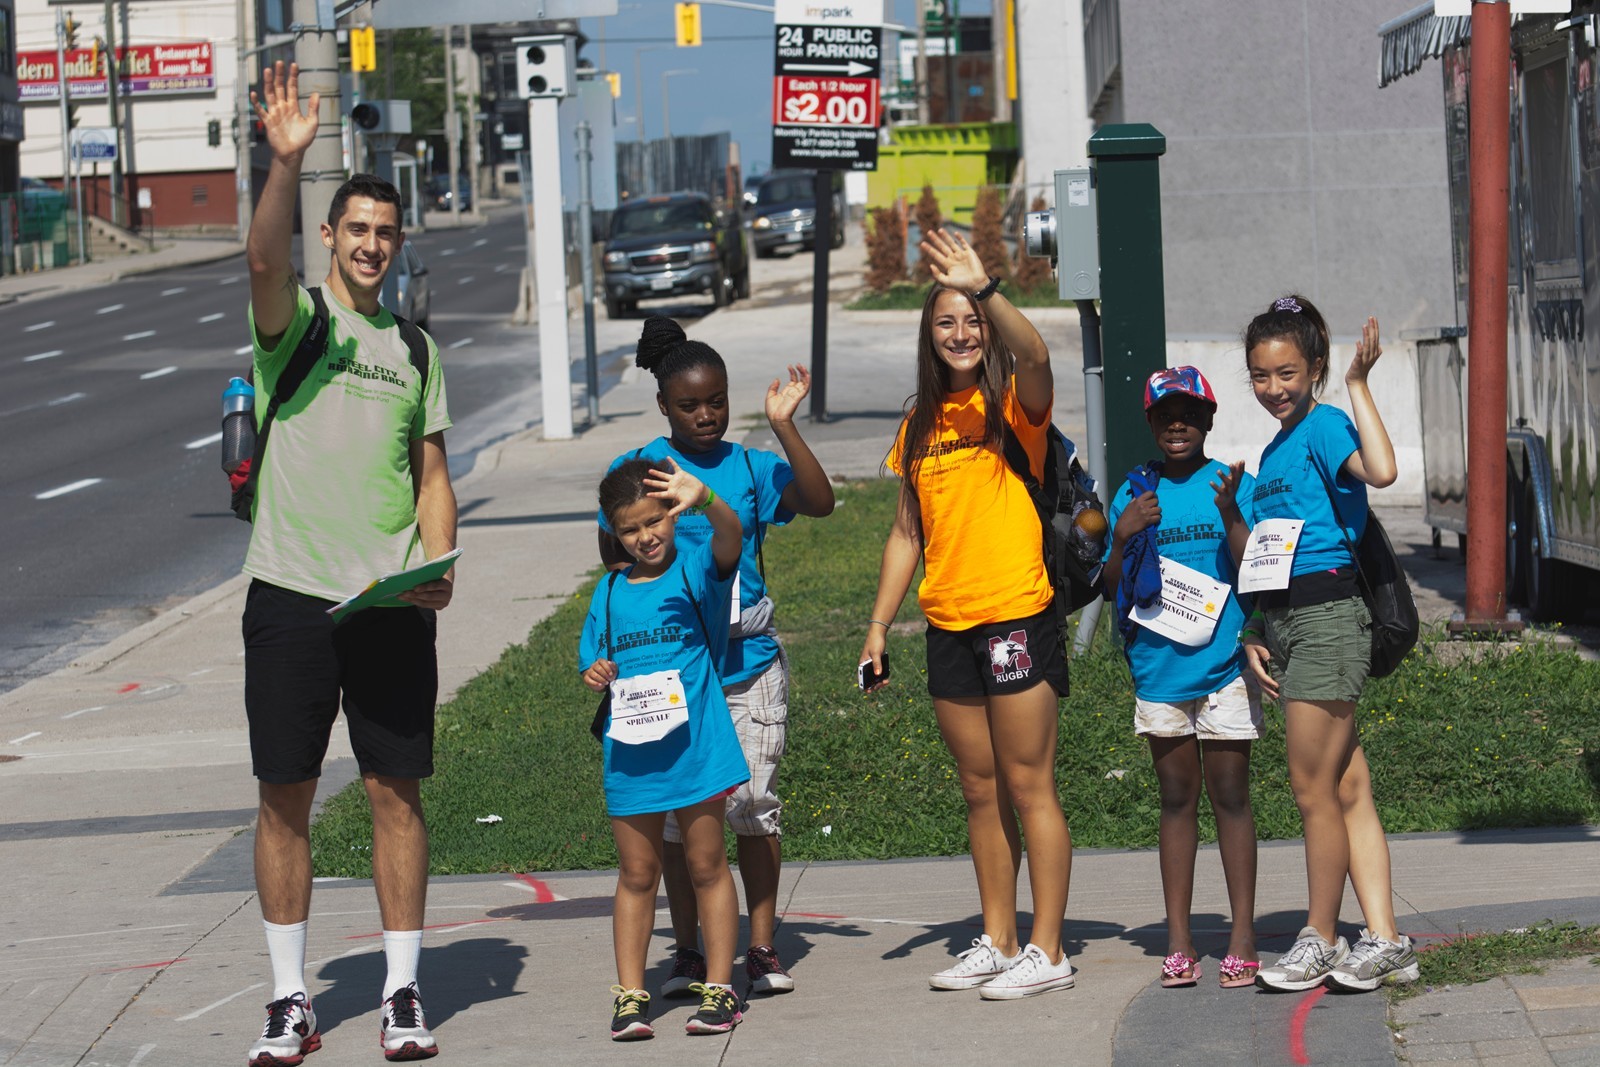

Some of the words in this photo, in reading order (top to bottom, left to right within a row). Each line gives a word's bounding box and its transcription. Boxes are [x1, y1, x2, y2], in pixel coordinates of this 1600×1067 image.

[805, 5, 853, 19] impark
[778, 26, 804, 47] 24
[813, 28, 873, 43] PUBLIC
[778, 47, 804, 56] HOUR
[806, 43, 878, 59] PARKING
[17, 56, 54, 80] dern
[789, 79, 818, 91] Each
[820, 81, 838, 92] 1/2
[840, 81, 867, 92] hour
[785, 93, 867, 124] $2.00
[774, 128, 807, 138] Monthly
[809, 129, 840, 139] Parking
[841, 130, 877, 139] Inquiries
[339, 357, 372, 372] STEEL
[374, 364, 398, 377] CITY
[328, 362, 379, 380] AMAZING
[381, 373, 408, 389] RACE
[950, 435, 971, 447] CITY
[1270, 484, 1293, 496] RACE
[1186, 524, 1215, 534] CITY
[1194, 531, 1225, 541] RACE
[1170, 578, 1187, 588] STEEL
[1190, 590, 1203, 598] RACE
[1155, 600, 1199, 623] SPRINGVALE
[617, 630, 651, 644] STEEL
[653, 625, 681, 636] CITY
[661, 632, 692, 643] RACE
[996, 669, 1029, 683] RUGBY
[626, 713, 670, 726] SPRINGVALE
